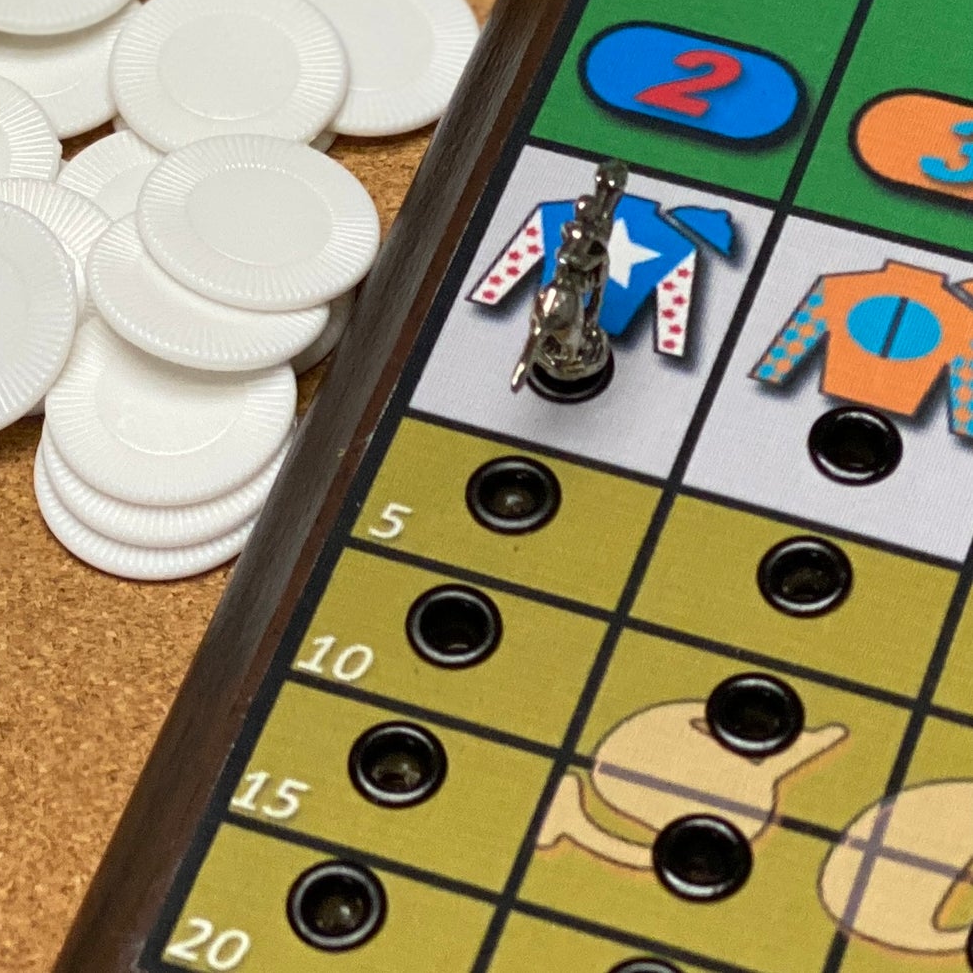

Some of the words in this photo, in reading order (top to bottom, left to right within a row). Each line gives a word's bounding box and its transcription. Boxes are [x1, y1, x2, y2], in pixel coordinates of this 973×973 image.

[633, 49, 743, 118] 2
[368, 502, 414, 540] 5
[296, 634, 375, 683] 10
[230, 770, 311, 820] 15
[164, 917, 252, 972] 20
